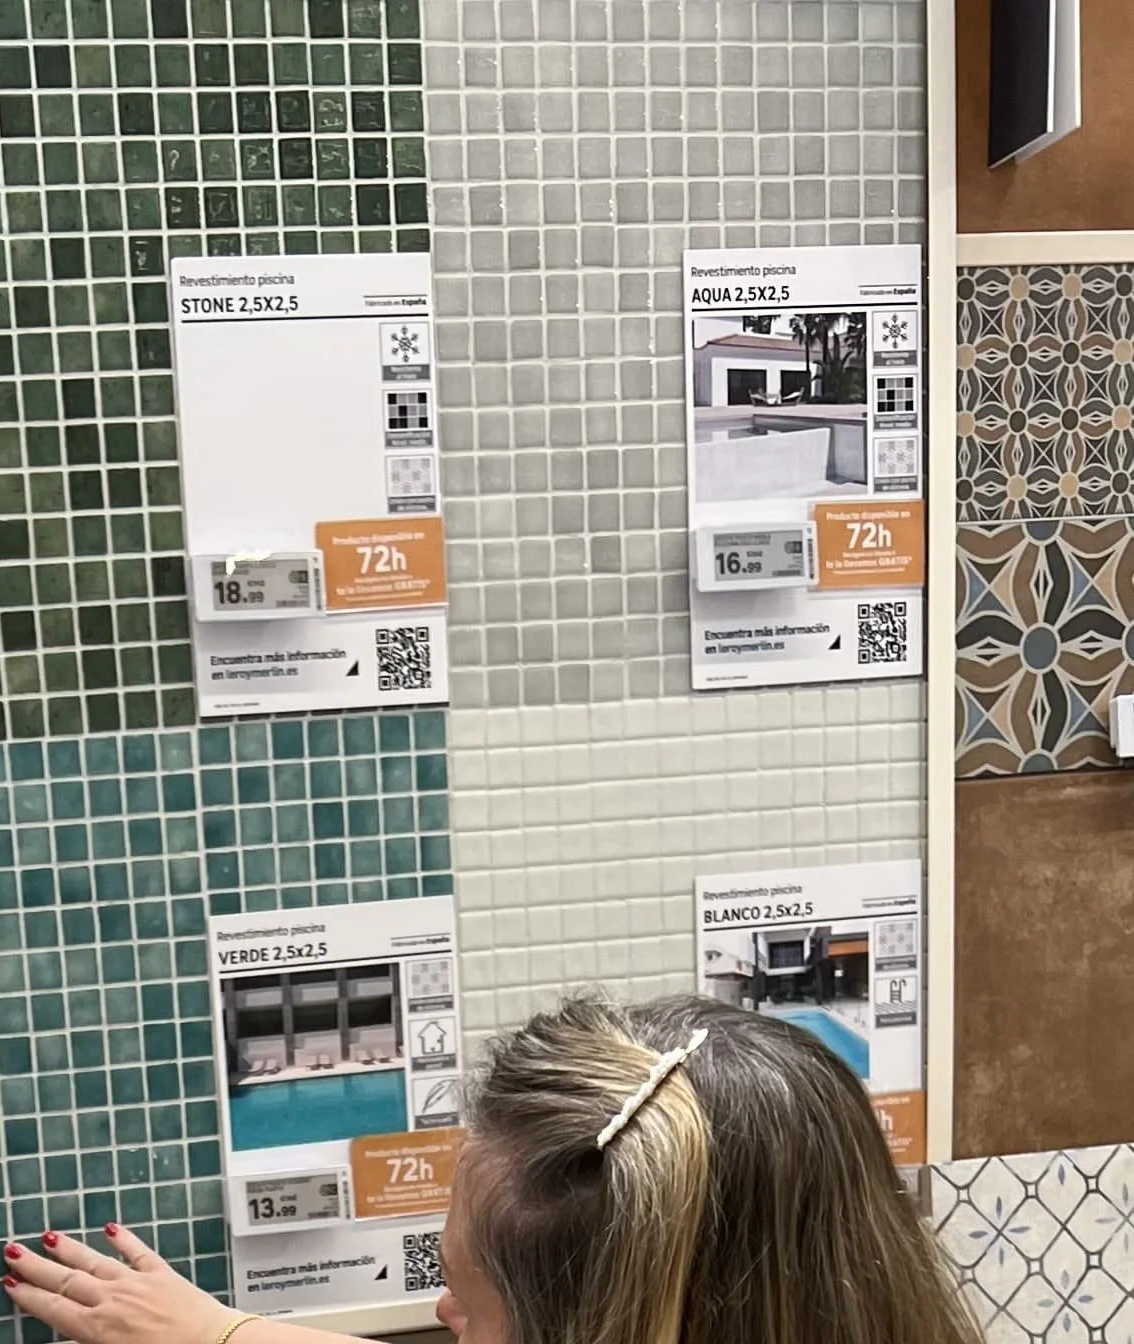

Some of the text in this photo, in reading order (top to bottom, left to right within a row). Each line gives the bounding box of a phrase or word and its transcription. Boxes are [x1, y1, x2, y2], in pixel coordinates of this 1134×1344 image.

[179, 272, 295, 288] Revestimiento piscina
[691, 264, 797, 278] Revestimiento piscina
[181, 296, 299, 315] STONE 2,5X2,5
[692, 285, 790, 304] AQUA 2,5X2,5
[846, 523, 892, 549] 72h
[356, 545, 407, 574] 72h
[715, 552, 762, 575] 16.99
[215, 580, 265, 605] 18.99
[704, 623, 830, 642] Encuentra más información
[211, 649, 347, 666] Encuentra más información
[703, 885, 803, 901] Revestimiento piscina
[704, 902, 814, 924] BLANCO 2,5x2,5
[217, 923, 326, 943] Revestimiento piscina
[219, 942, 328, 966] VERDE 2,5x2,5
[386, 1157, 433, 1184] 72h
[248, 1197, 297, 1220] 13.99
[246, 1255, 376, 1280] Encuentra más información
